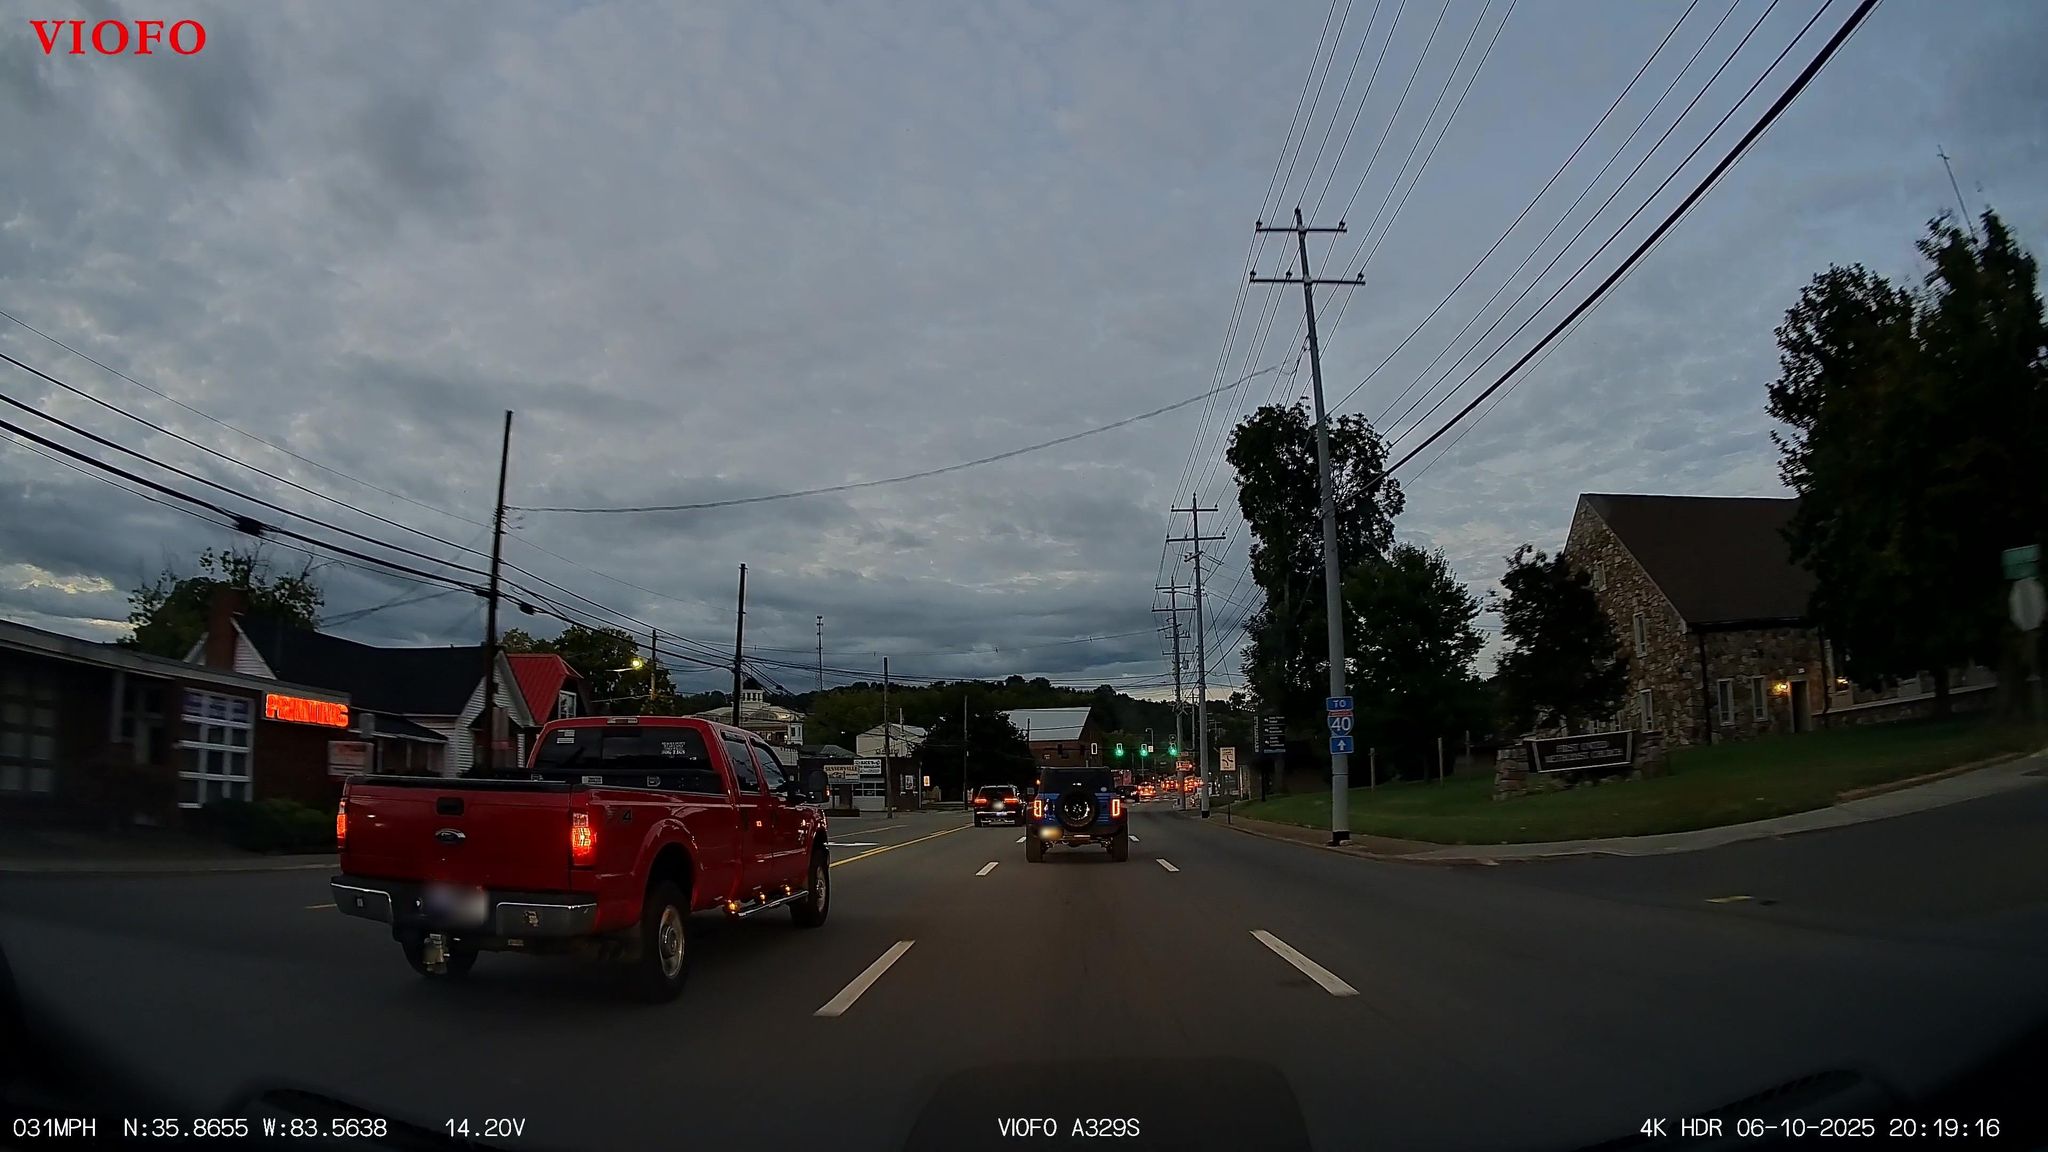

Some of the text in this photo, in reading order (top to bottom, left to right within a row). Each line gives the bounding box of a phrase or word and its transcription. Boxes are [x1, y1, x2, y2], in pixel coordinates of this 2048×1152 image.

[266, 693, 349, 727] PRINTING
[1333, 699, 1347, 708] TO
[1331, 716, 1352, 732] 40
